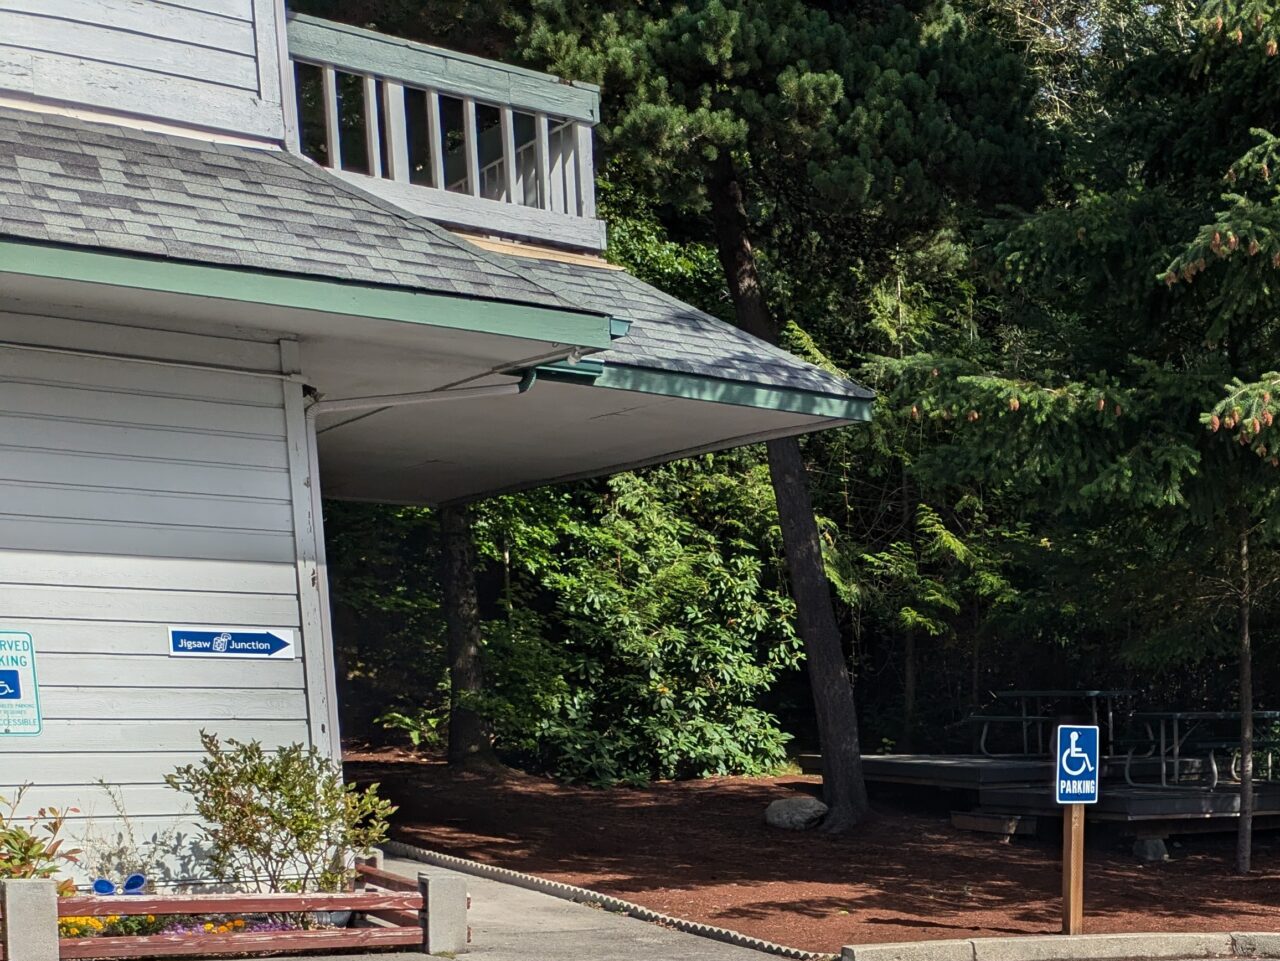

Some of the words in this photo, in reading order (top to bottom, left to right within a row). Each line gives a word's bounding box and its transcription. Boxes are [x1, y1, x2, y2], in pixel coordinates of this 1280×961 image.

[178, 638, 210, 649] Jigsaw
[229, 641, 270, 650] Junction
[1060, 780, 1095, 793] PARKING
